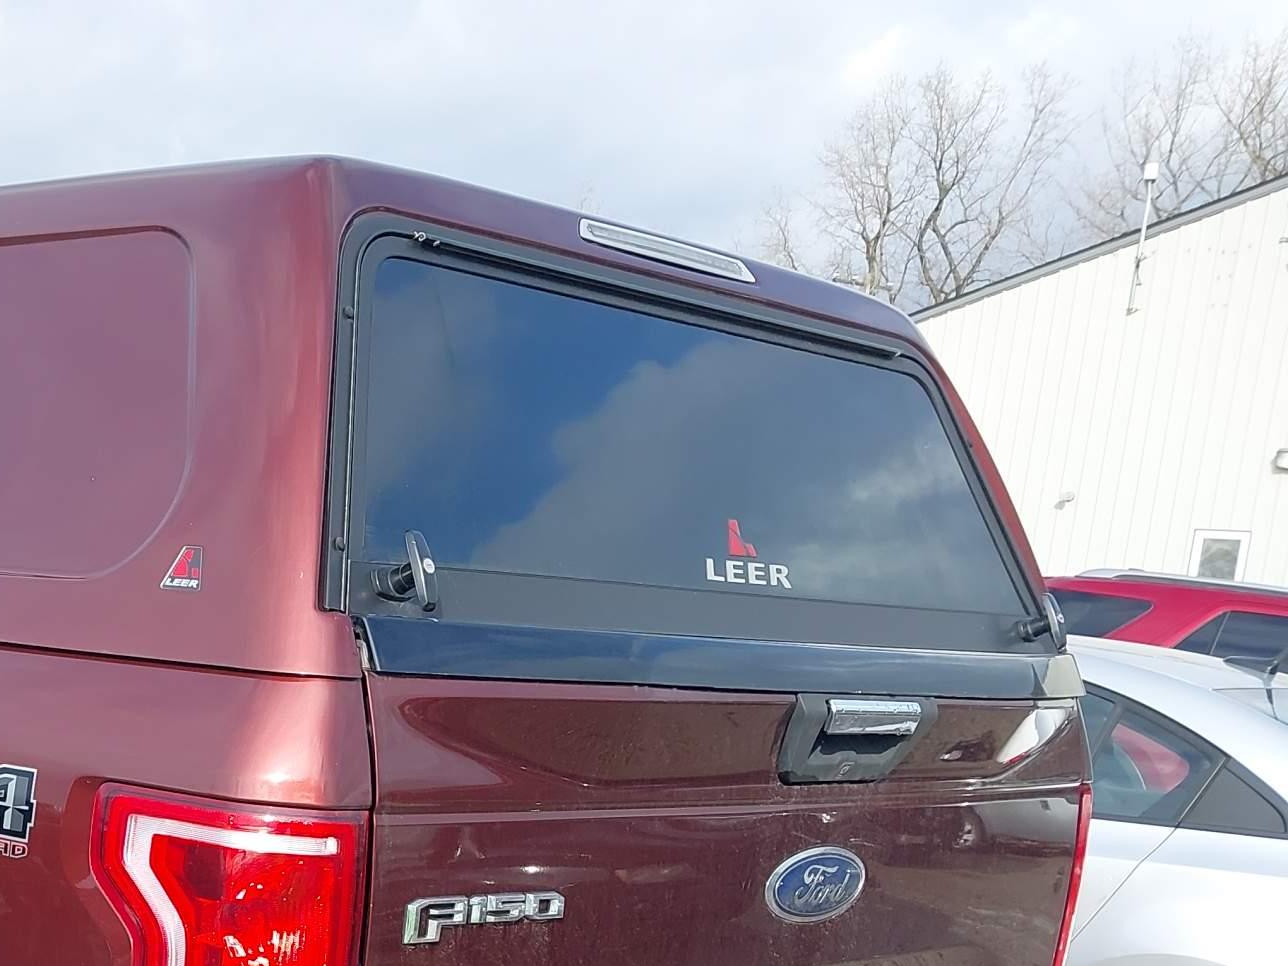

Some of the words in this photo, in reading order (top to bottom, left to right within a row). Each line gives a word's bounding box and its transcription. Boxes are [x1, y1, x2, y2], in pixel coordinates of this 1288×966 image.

[164, 577, 199, 589] LEER
[705, 557, 793, 589] LEER
[793, 864, 851, 905] Ford
[401, 890, 566, 945] F150
